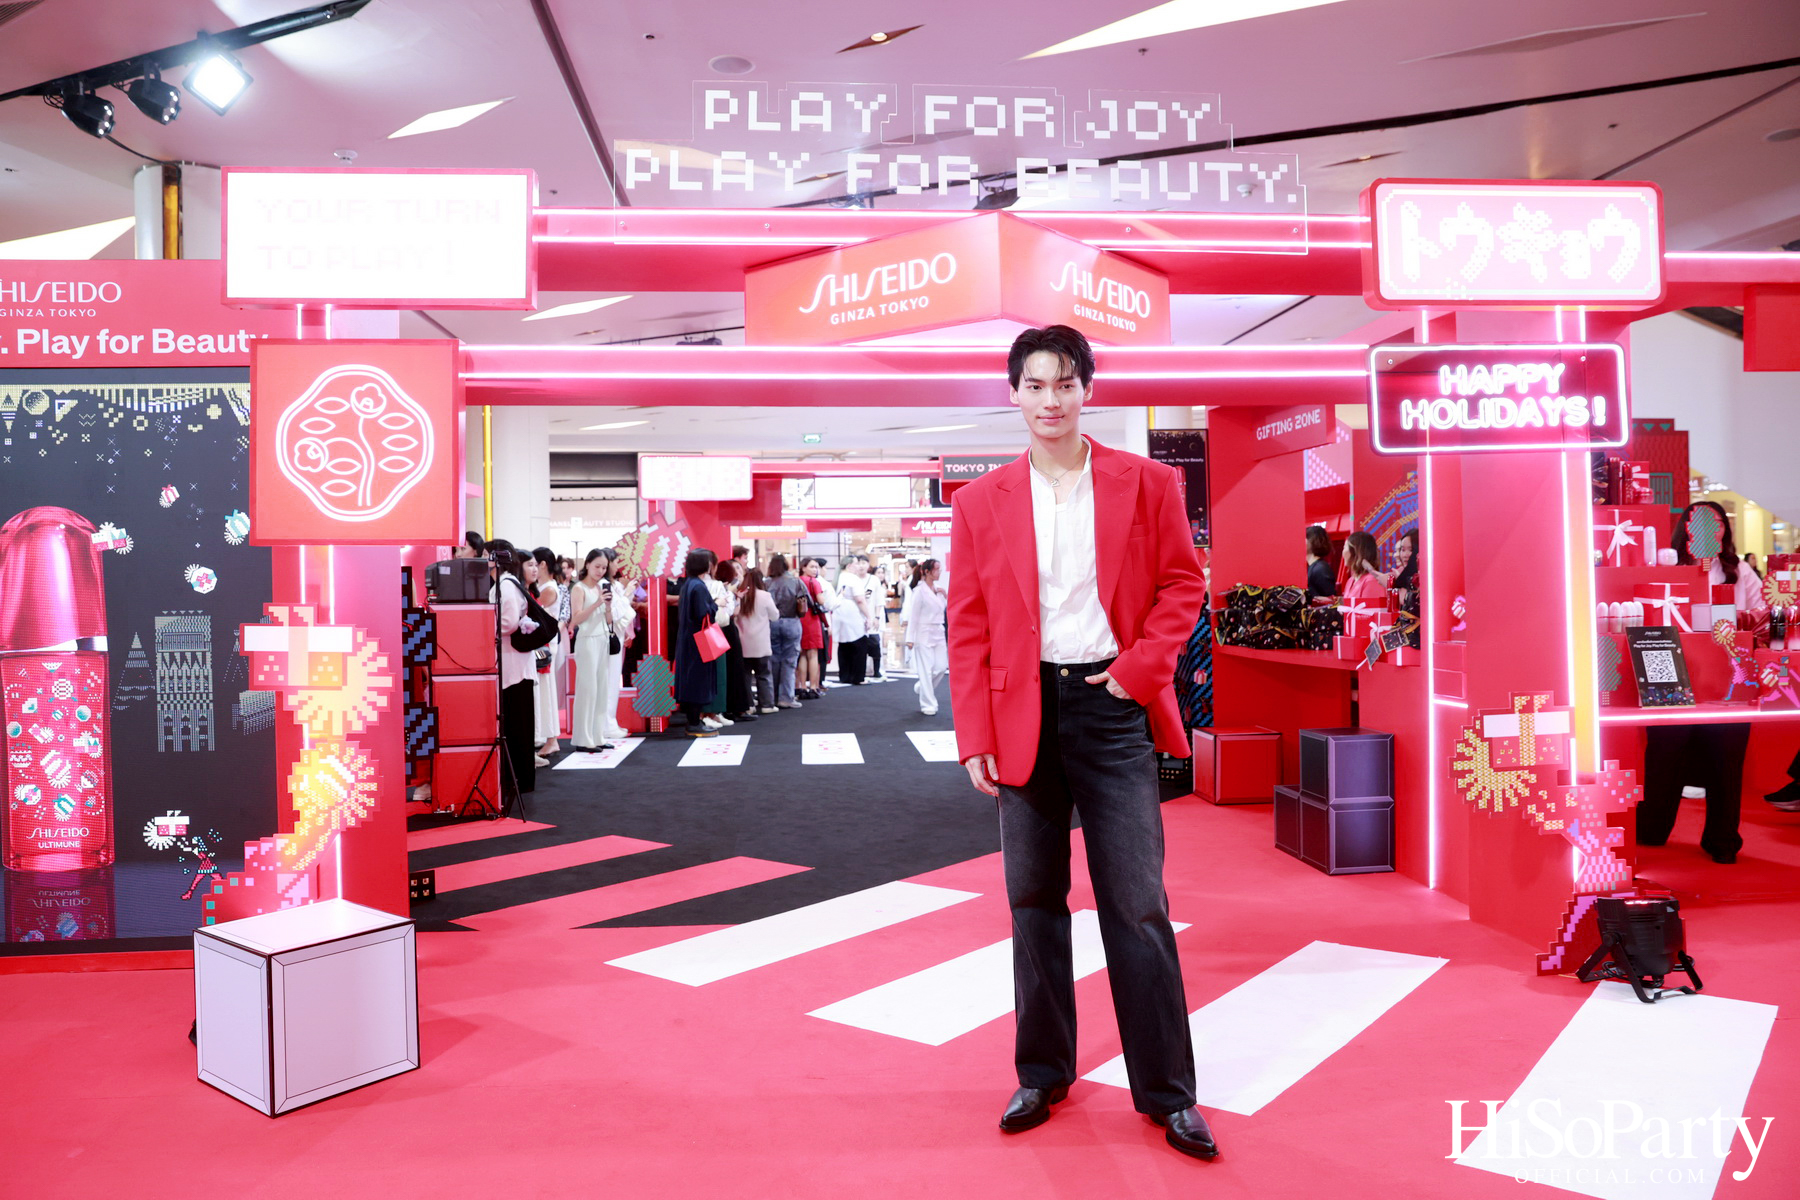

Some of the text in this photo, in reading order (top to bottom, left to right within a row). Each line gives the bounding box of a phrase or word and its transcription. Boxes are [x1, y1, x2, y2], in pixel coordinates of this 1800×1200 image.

[705, 90, 1211, 141] PLAY FOR JOY
[626, 149, 1297, 203] PLAY FOR BEAUTY.
[255, 199, 501, 224] YOUR TURN
[1400, 200, 1641, 283] トウキョウ
[256, 245, 312, 271] TO
[0, 281, 122, 303] HISEIDO
[799, 252, 957, 314] SHISEIDO
[1050, 261, 1151, 319] SHISEIDO
[0, 308, 97, 317] GINZA TOKYO
[830, 295, 930, 325] GINZA TOKYO
[1073, 304, 1137, 332] GINZA TOKYO
[17, 328, 90, 359] Play
[97, 328, 144, 354] for
[1439, 363, 1566, 395] HAPPY
[1256, 408, 1321, 441] GIFTING ZONE
[1401, 395, 1607, 430] HOLIDAYS!
[944, 463, 985, 473] TOKYO
[26, 827, 90, 839] SHISEIDO
[38, 841, 81, 849] ULTIMUNE
